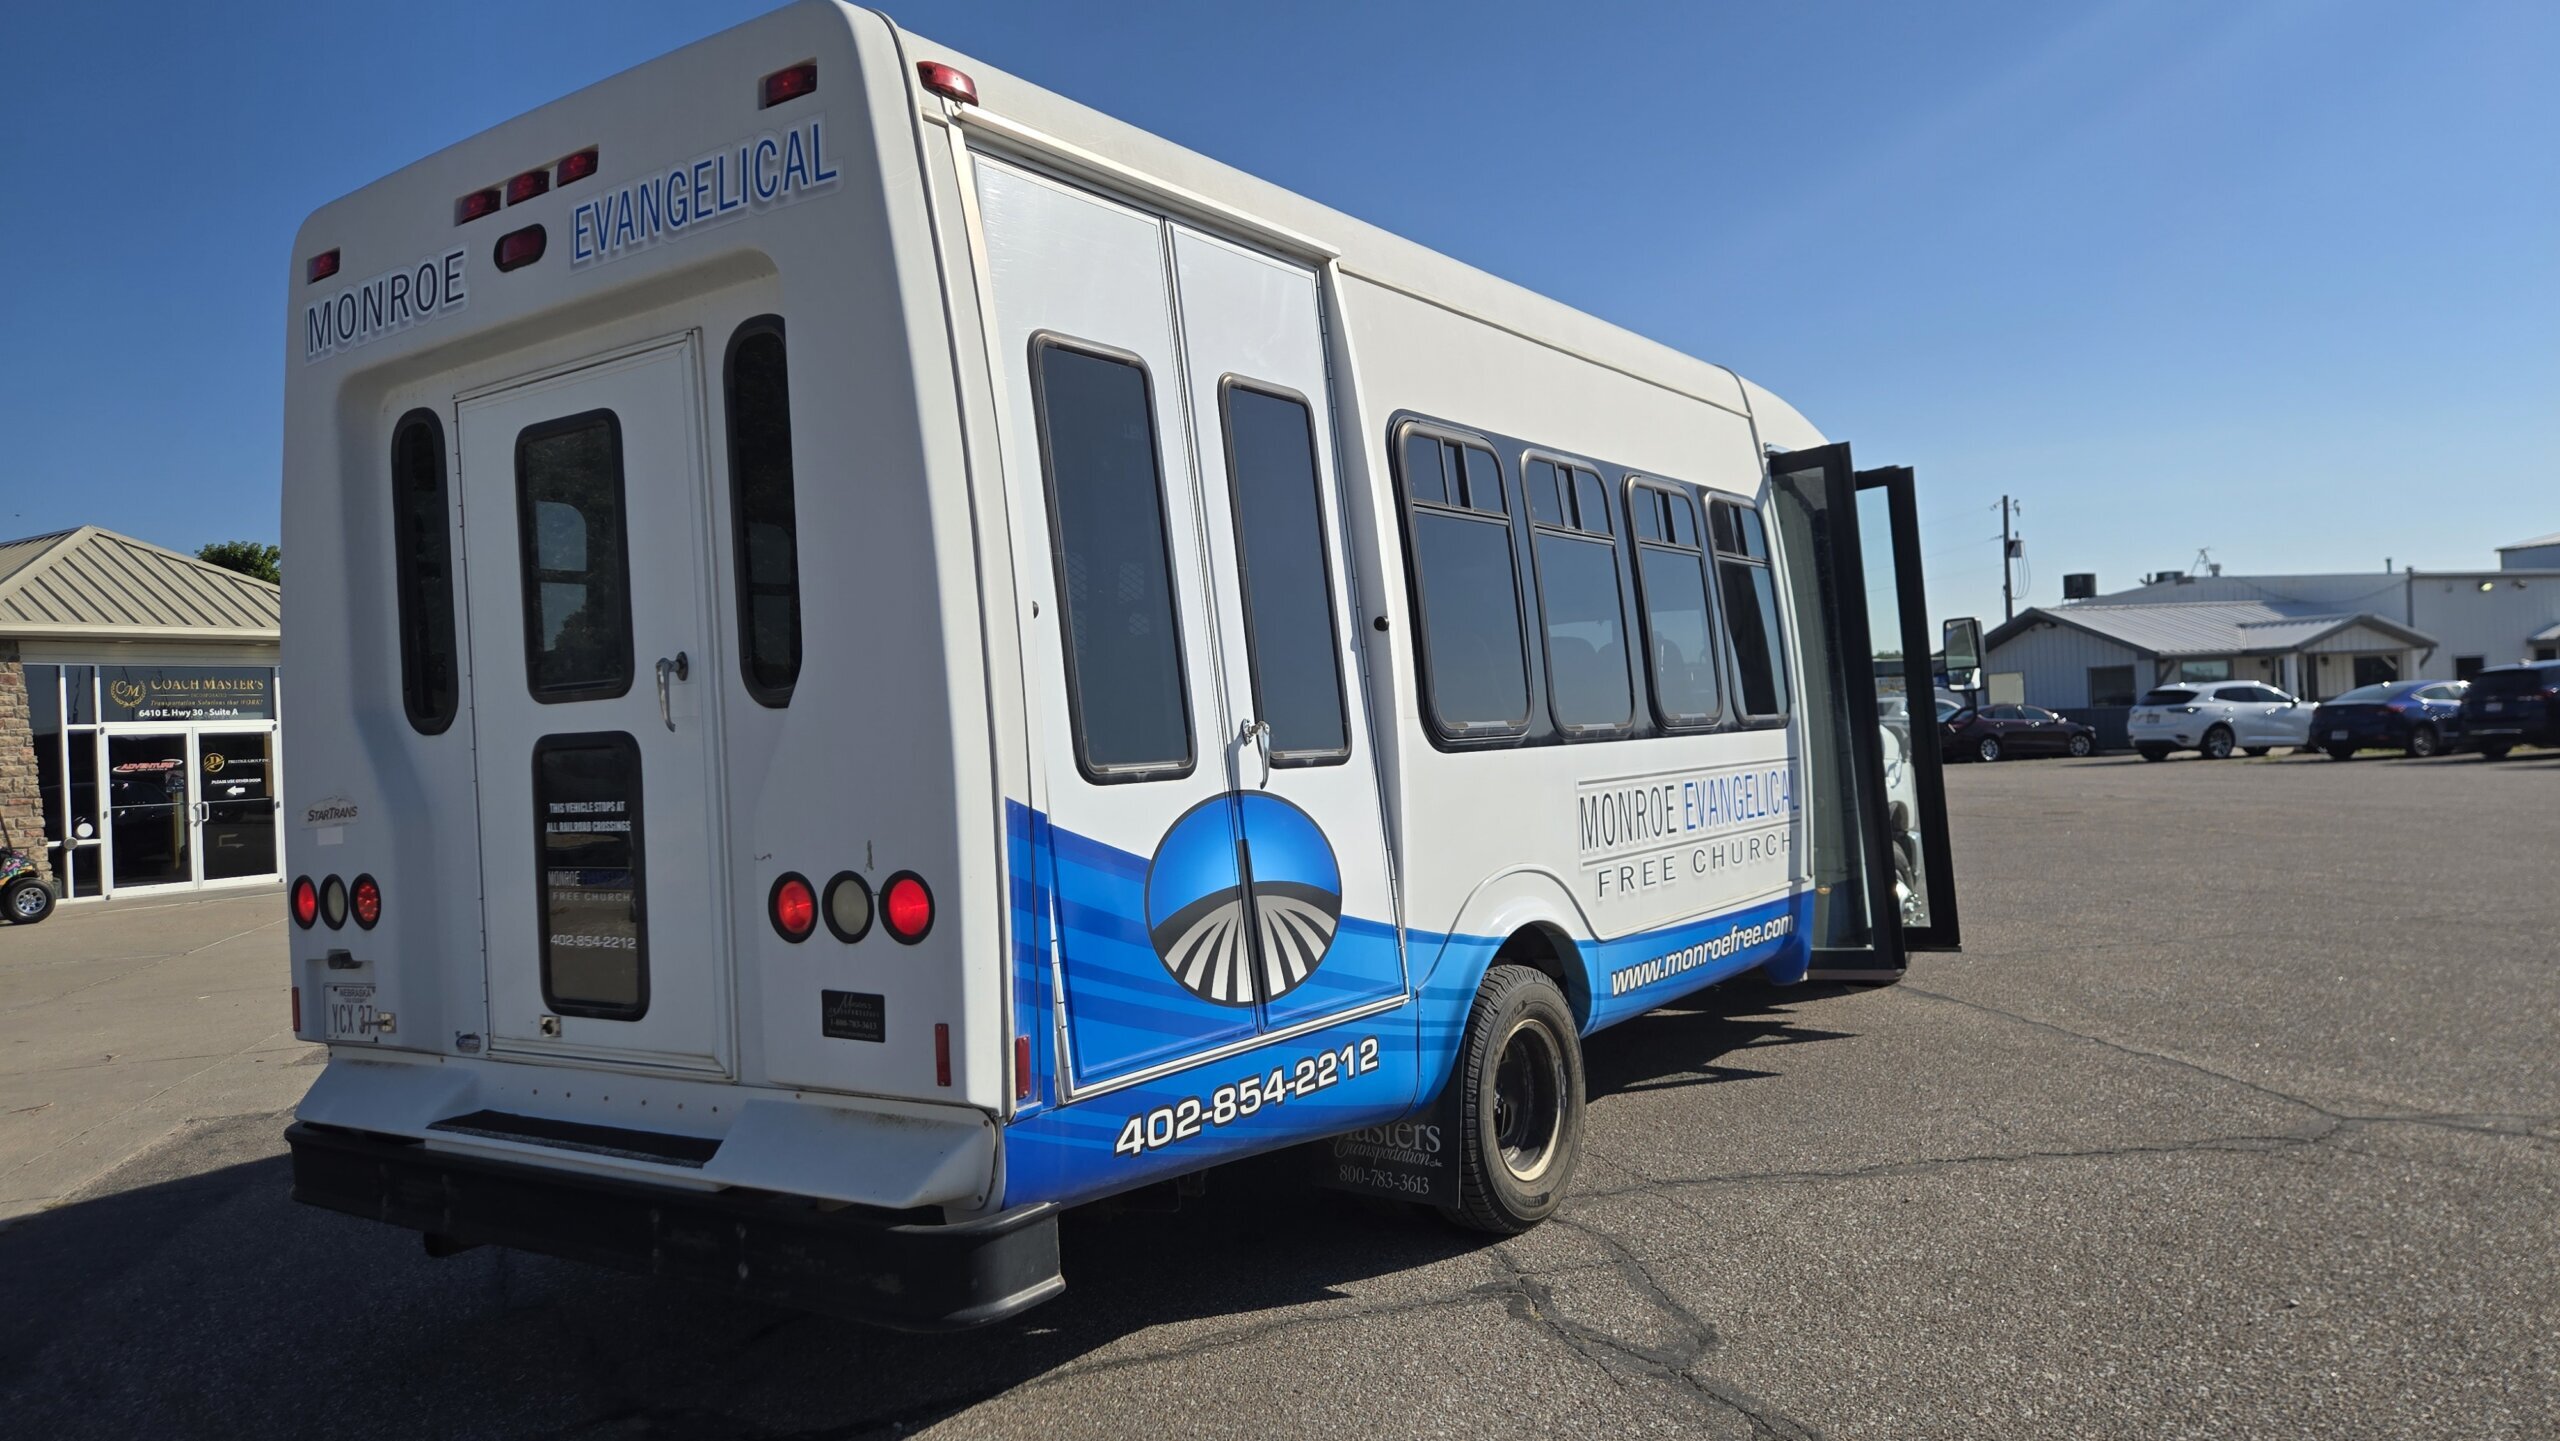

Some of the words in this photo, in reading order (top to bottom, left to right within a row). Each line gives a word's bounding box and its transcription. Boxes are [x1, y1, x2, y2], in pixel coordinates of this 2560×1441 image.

[308, 250, 464, 353] MONROE
[575, 123, 837, 260] EVANGELICAL
[151, 679, 199, 690] COACH
[203, 678, 264, 690] MASTER'S
[139, 709, 161, 717] 6410
[171, 709, 191, 718] Hwy
[209, 708, 230, 716] Suite
[121, 762, 175, 770] ADVENTURE
[549, 803, 564, 813] THIS
[565, 802, 594, 813] VEHICLE
[594, 801, 616, 812] STOPS
[616, 801, 625, 812] AT
[1579, 785, 1677, 850] MONROE
[1684, 768, 1799, 830] EVANGELICAL
[546, 823, 559, 832] ALL
[559, 822, 592, 832] RAILROAD
[592, 821, 631, 832] CROSSINGS
[1599, 855, 1676, 897] FREE
[1692, 831, 1791, 873] CHURCH
[547, 870, 581, 887] MONROE
[552, 892, 580, 901] FREE
[583, 892, 630, 901] CHURCH
[550, 934, 636, 949] 402-854-2212
[1612, 914, 1794, 996] www.monroefree.com
[332, 1004, 354, 1034] YCX
[1115, 1036, 1380, 1155] 402-854-2212
[1339, 1164, 1430, 1195] 800-783-3613
